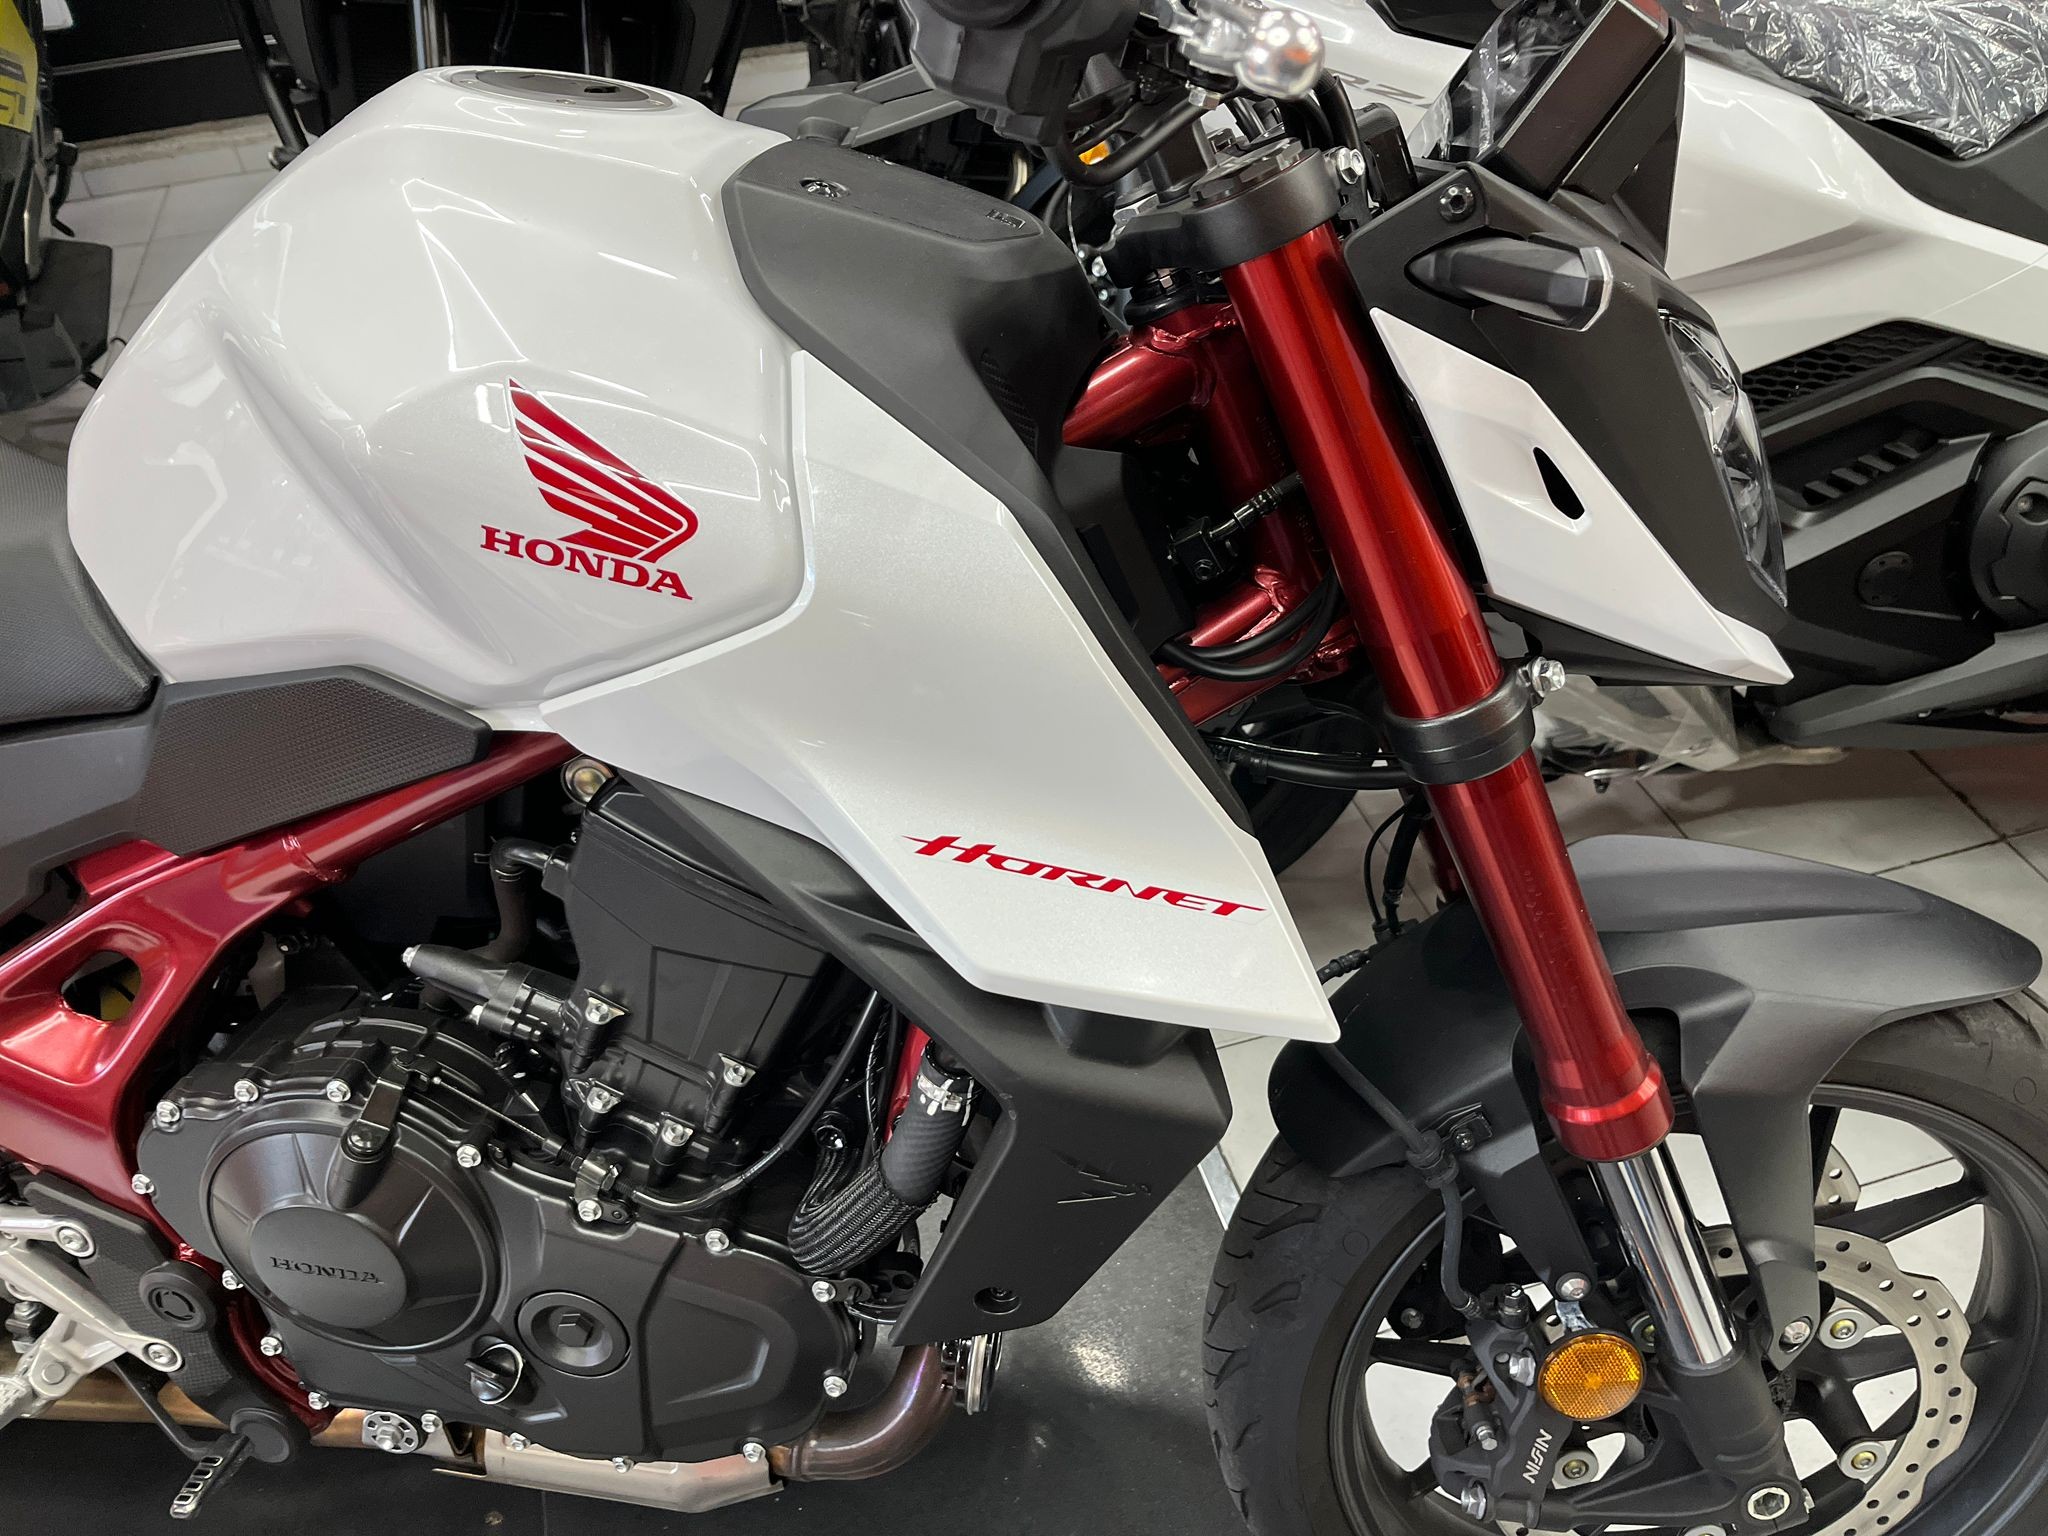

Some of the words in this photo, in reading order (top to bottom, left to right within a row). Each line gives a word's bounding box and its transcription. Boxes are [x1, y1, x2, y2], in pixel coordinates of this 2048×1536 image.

[480, 524, 693, 601] HONDA
[901, 835, 1268, 917] HORNET
[269, 1256, 385, 1284] HONDA
